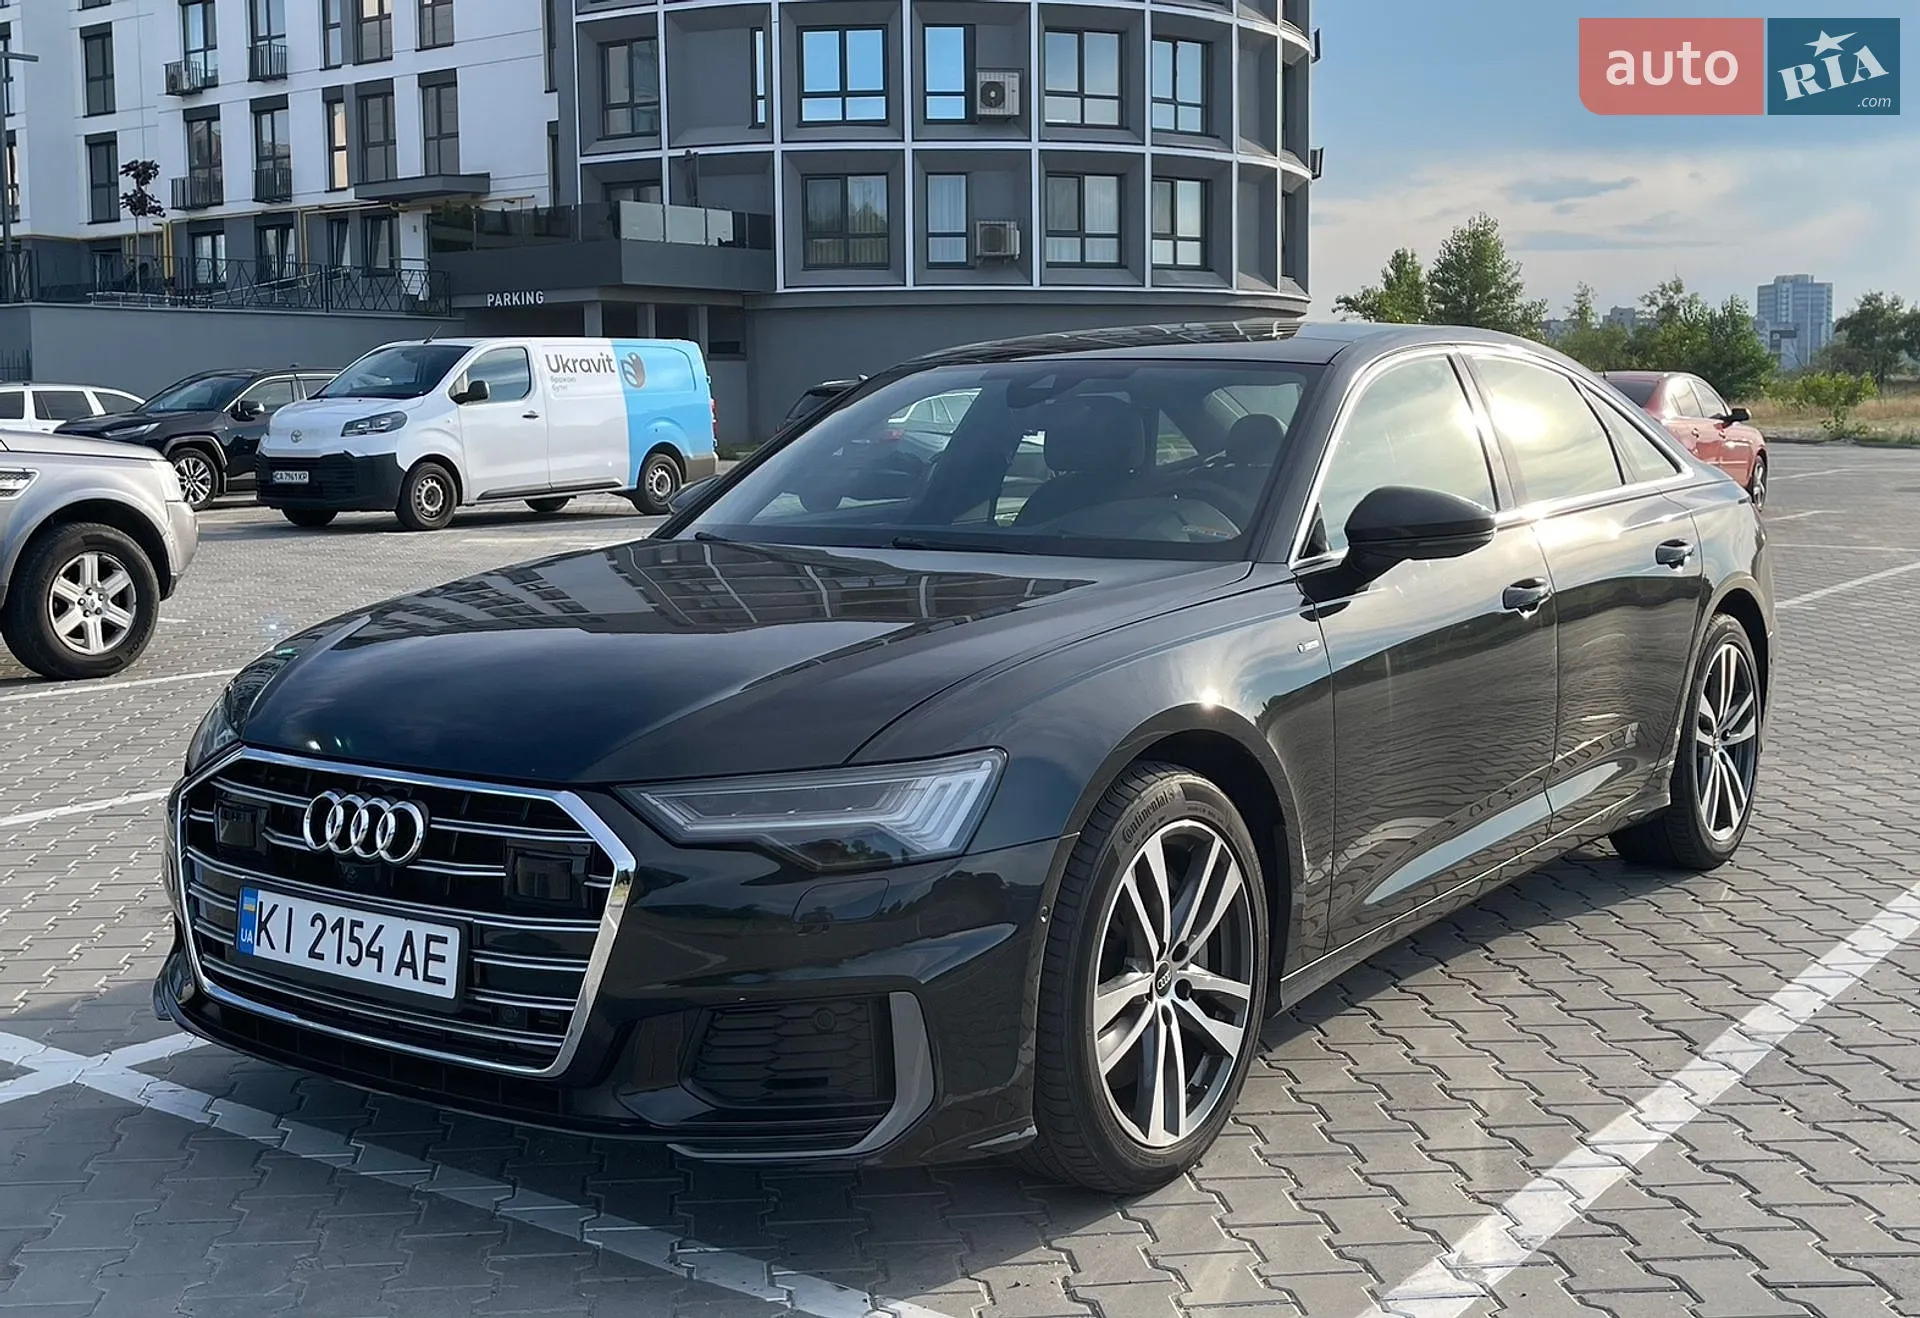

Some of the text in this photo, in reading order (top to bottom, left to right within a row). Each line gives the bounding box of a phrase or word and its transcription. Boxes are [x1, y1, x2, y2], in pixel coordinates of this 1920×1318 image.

[487, 290, 544, 307] PARKING
[545, 352, 615, 373] Ukravit
[1122, 790, 1170, 843] Continental
[240, 927, 253, 945] UA
[256, 900, 449, 986] KI 2154 AE
